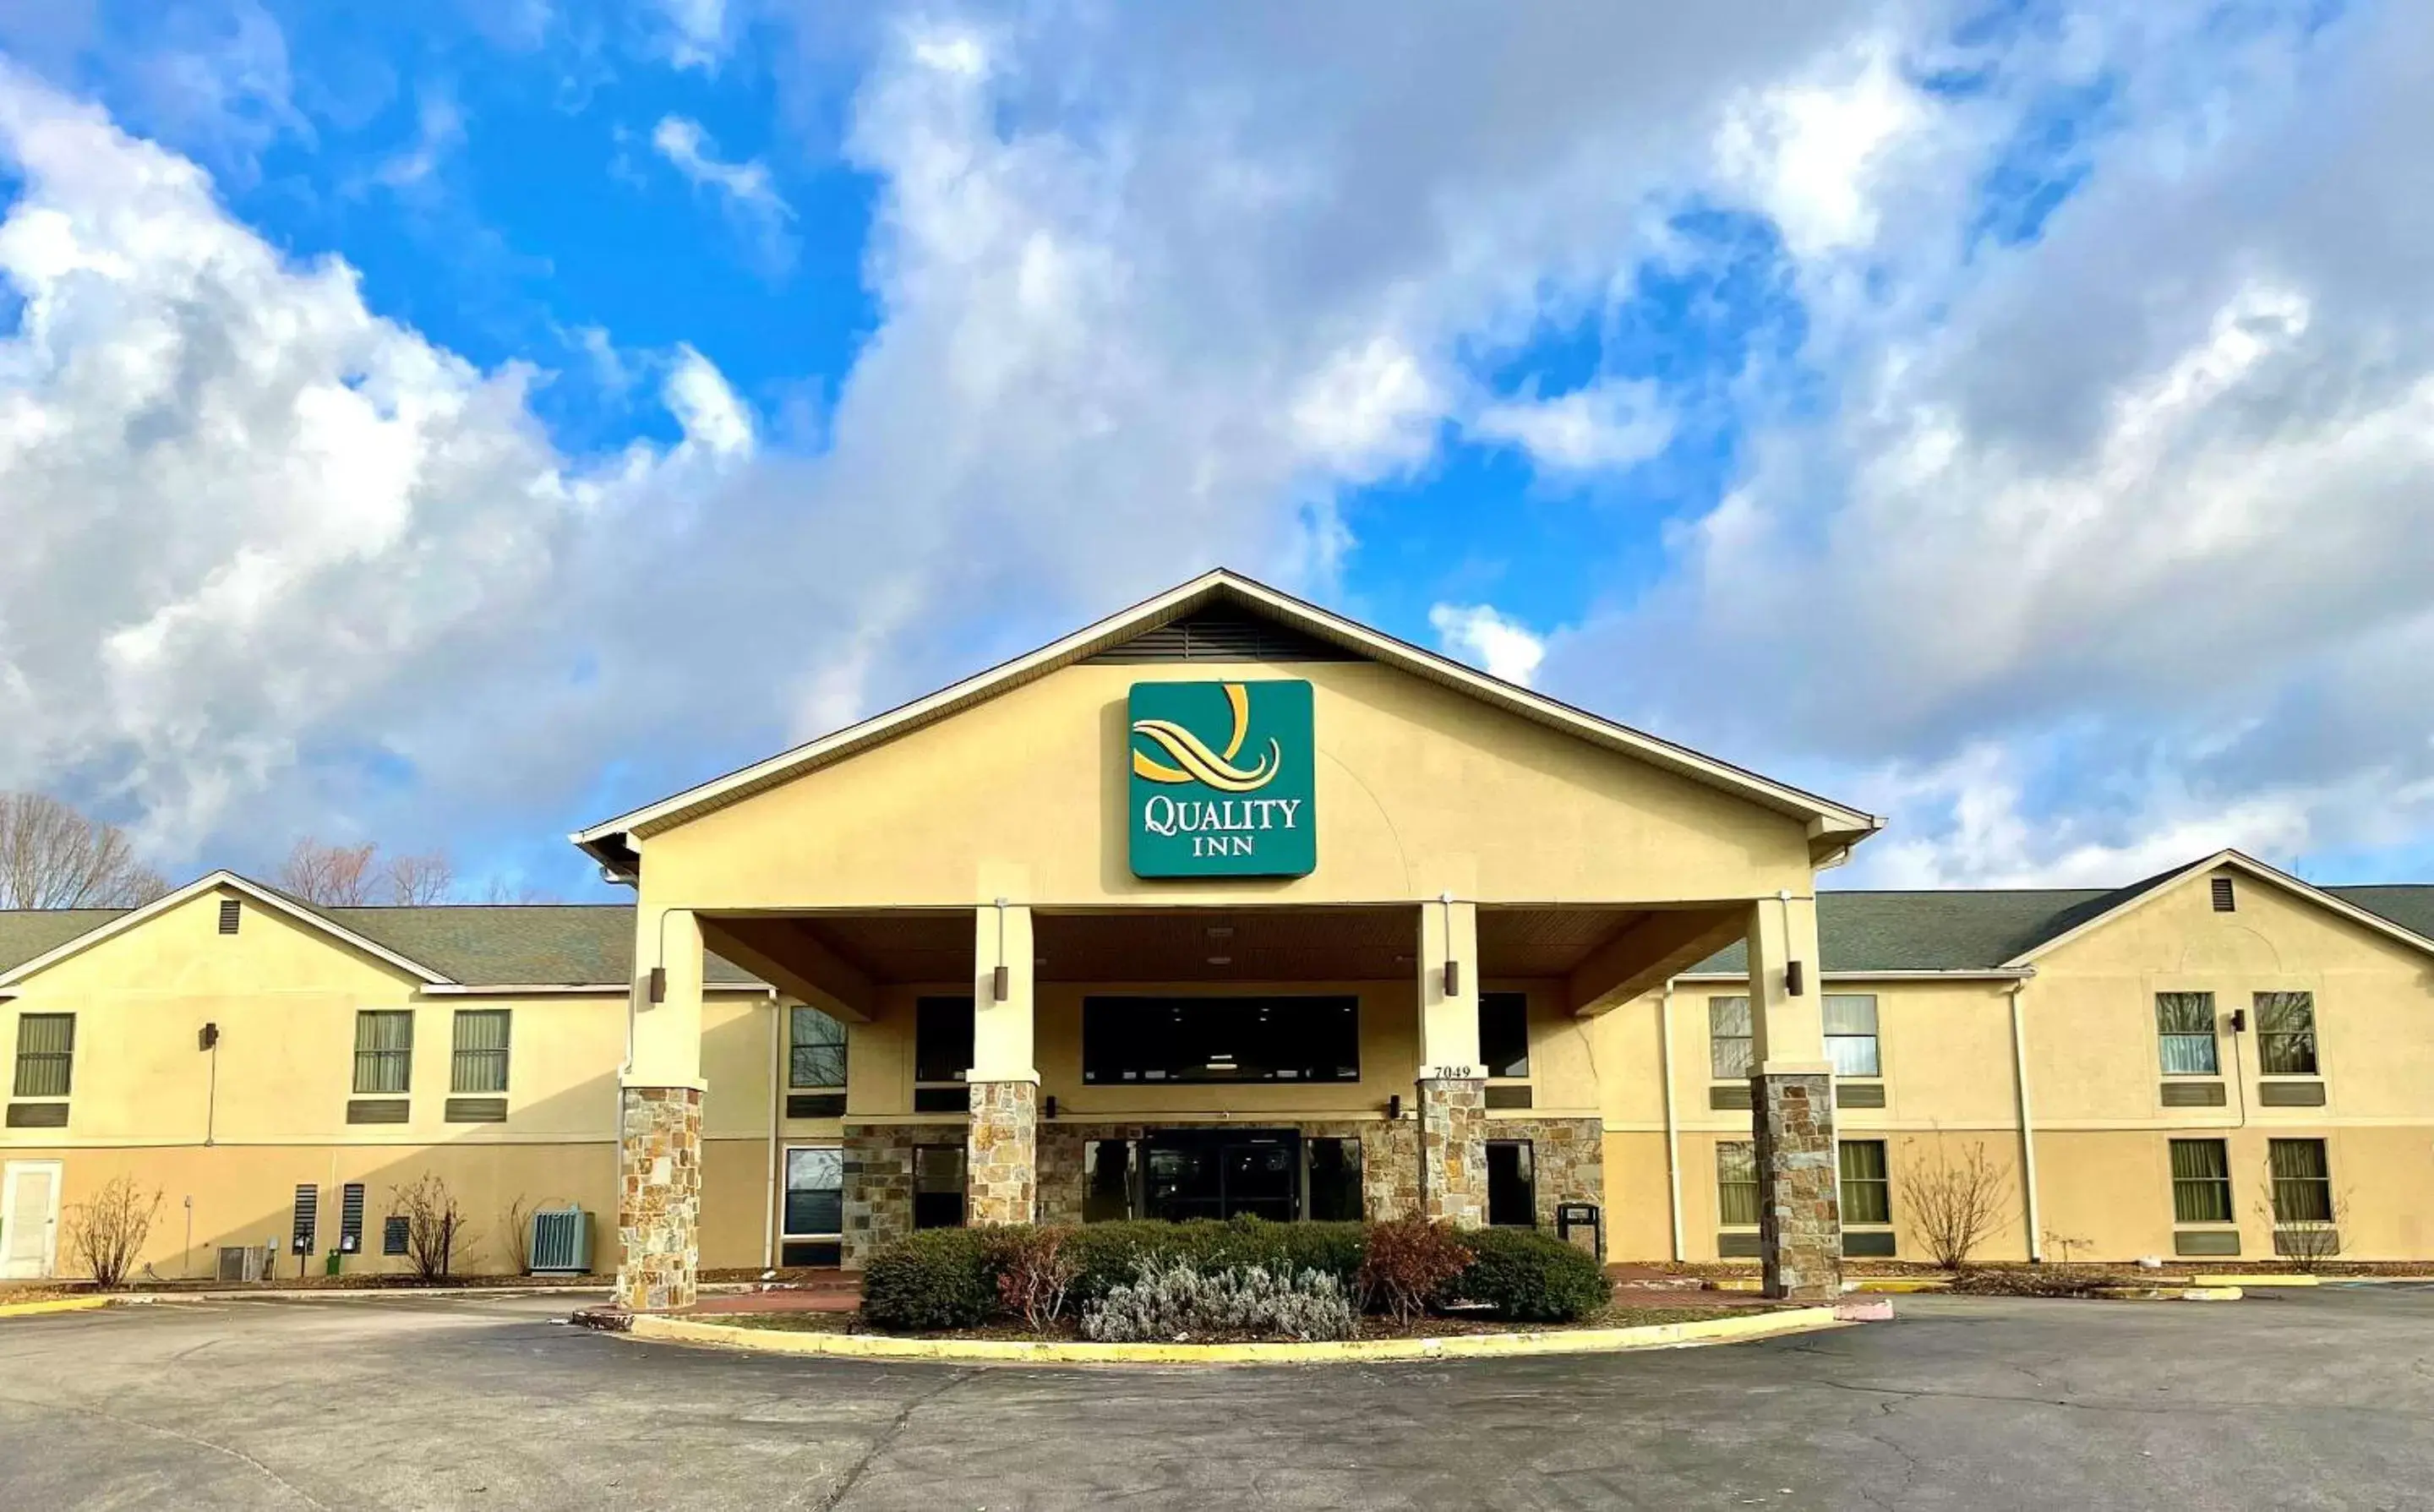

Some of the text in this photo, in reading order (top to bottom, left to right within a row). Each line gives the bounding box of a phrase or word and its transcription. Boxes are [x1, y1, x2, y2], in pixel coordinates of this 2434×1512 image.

[1144, 795, 1302, 836] QUALITY
[1192, 836, 1253, 857] INN
[1434, 1066, 1471, 1079] 7049
